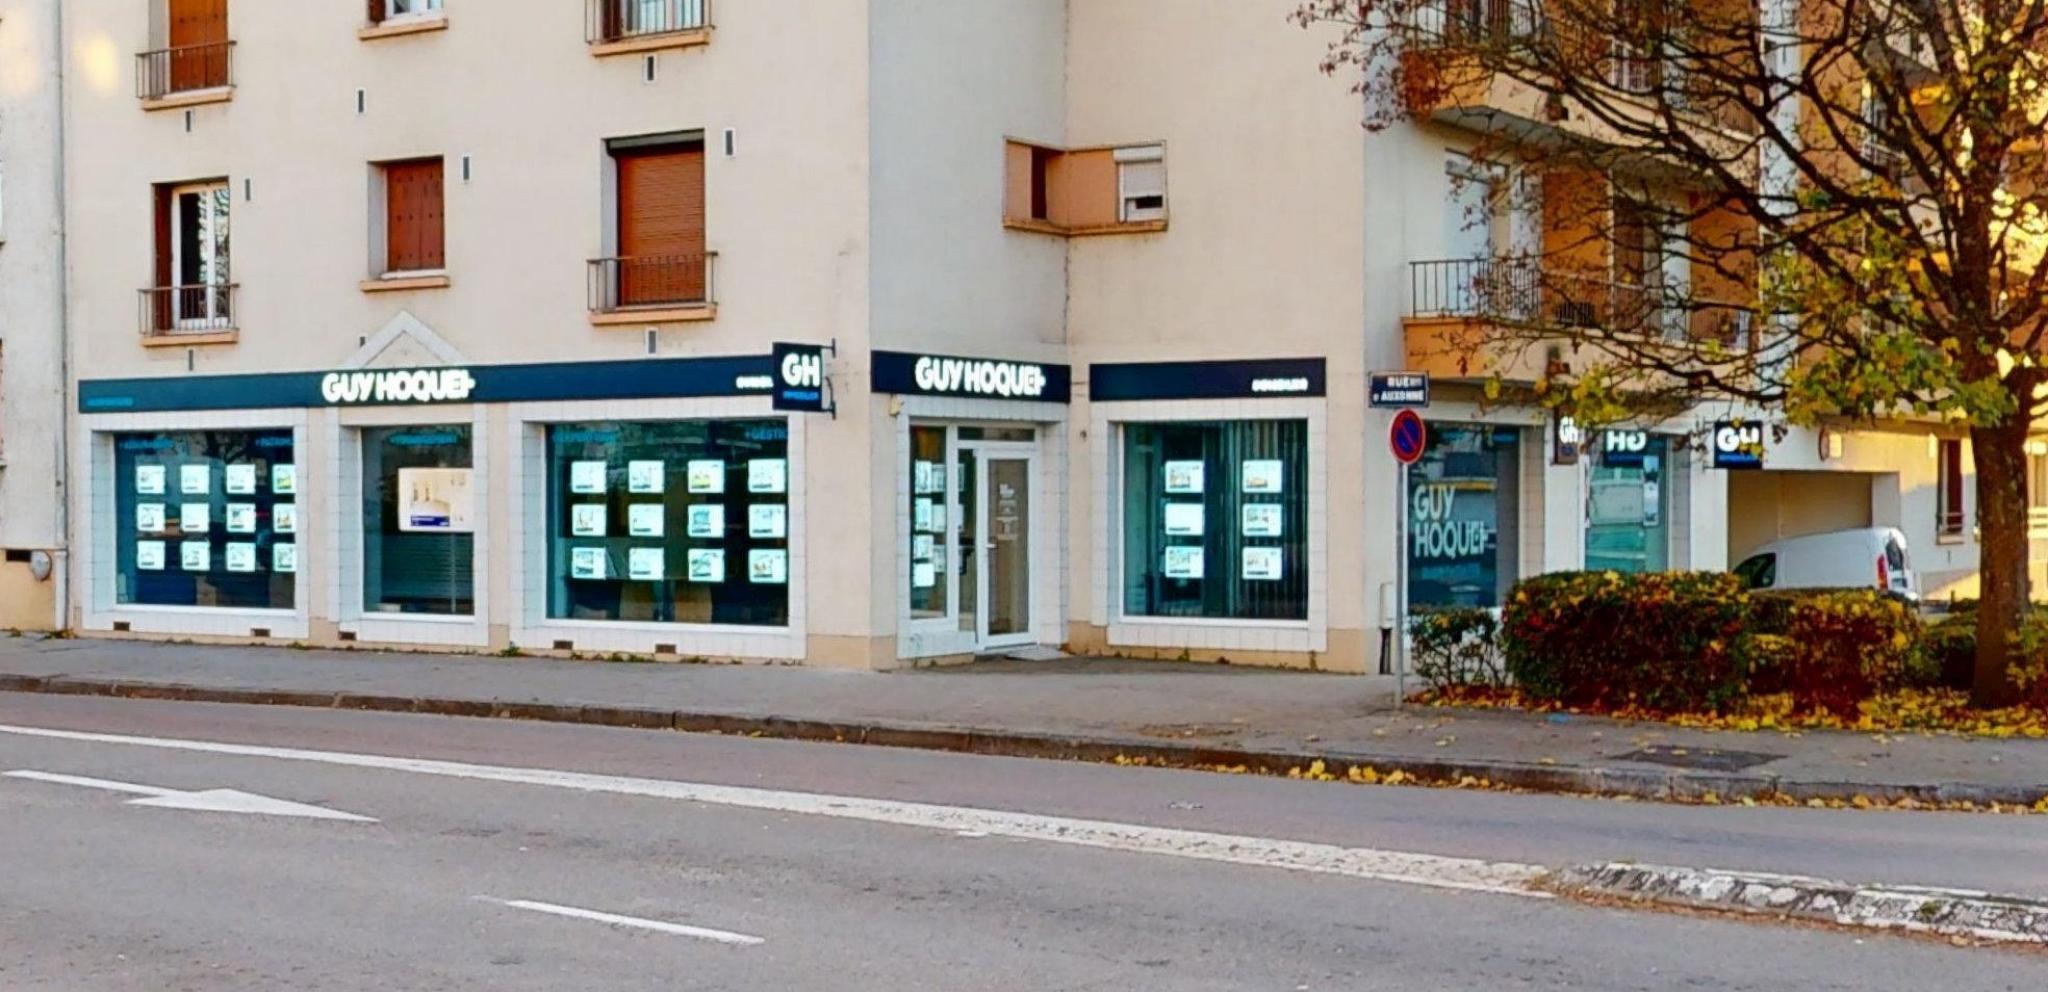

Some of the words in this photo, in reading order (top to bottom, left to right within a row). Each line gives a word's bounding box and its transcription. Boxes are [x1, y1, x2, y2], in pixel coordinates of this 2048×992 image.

[322, 372, 374, 402] GUY
[782, 353, 820, 387] GH
[915, 356, 963, 391] GUY
[1414, 484, 1455, 520] GUY
